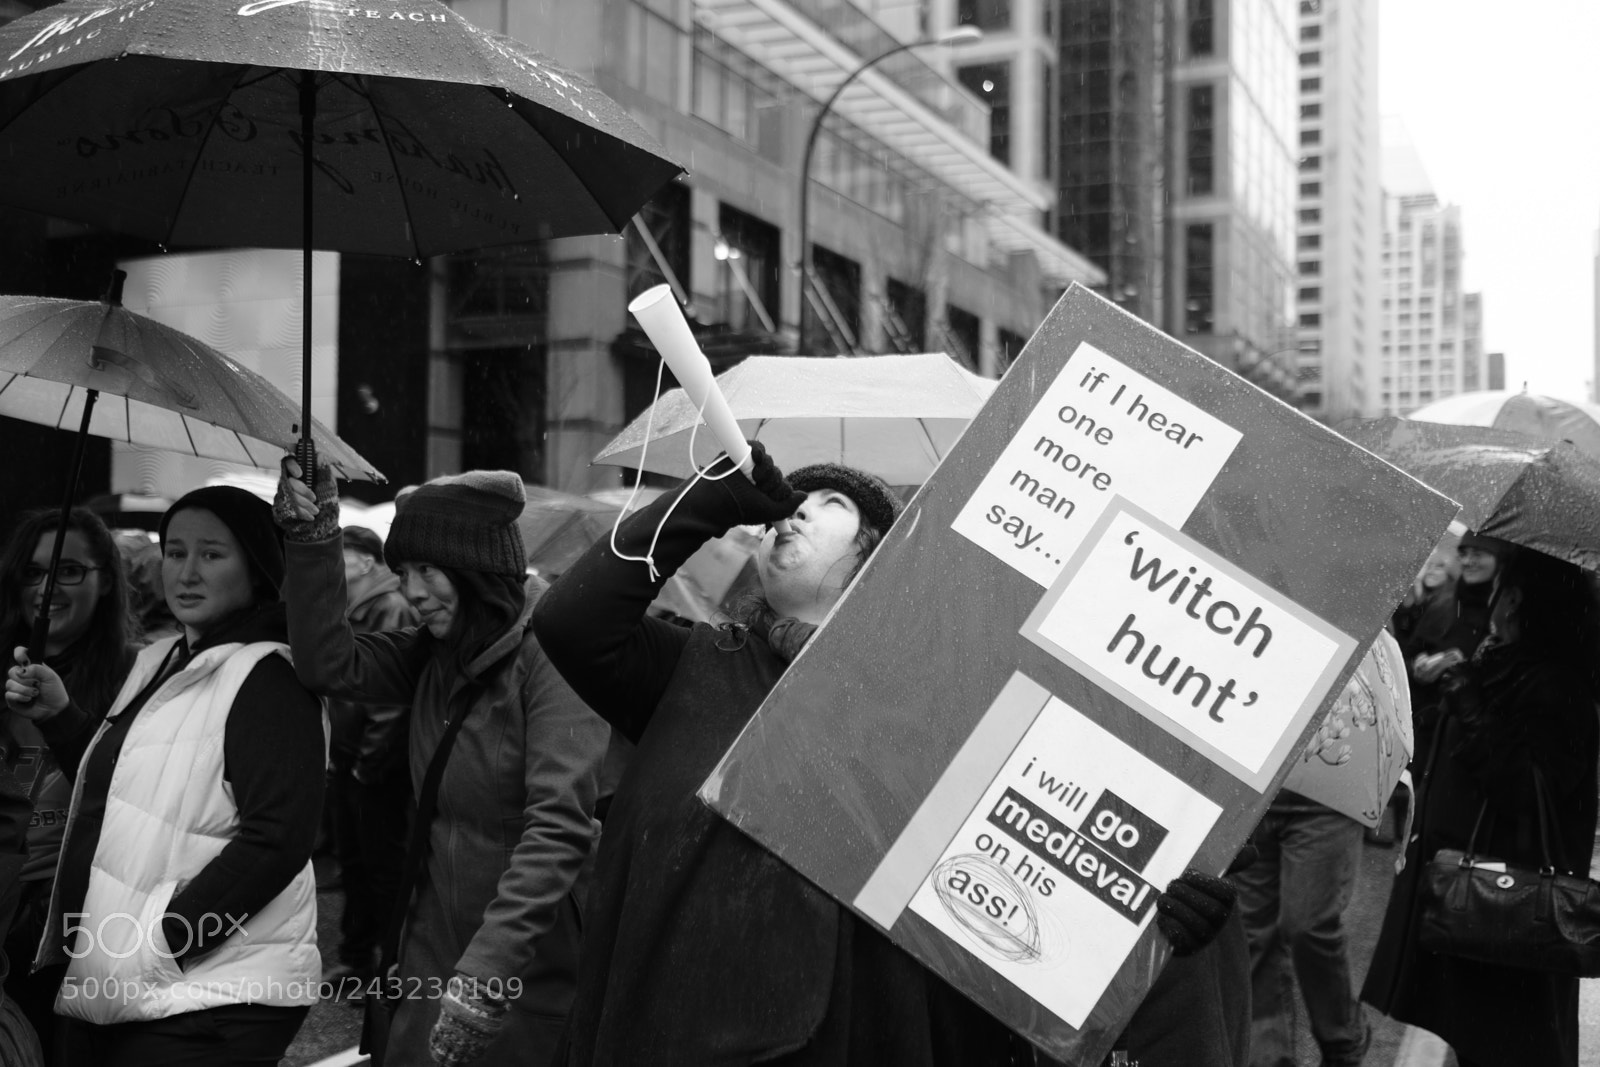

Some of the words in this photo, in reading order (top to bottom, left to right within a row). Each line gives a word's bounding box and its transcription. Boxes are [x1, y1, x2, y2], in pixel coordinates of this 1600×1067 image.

[341, 8, 447, 23] TEACH
[1058, 403, 1115, 447] one
[1078, 366, 1109, 395] if
[1109, 384, 1127, 406] I
[1126, 393, 1204, 451] hear
[1033, 433, 1113, 492] more
[1009, 468, 1077, 520] man
[985, 503, 1062, 566] say...
[29, 809, 70, 828] GBY
[1021, 756, 1038, 778] i
[1038, 769, 1088, 812] will
[1089, 803, 1141, 850] go
[974, 831, 1012, 867] on
[1012, 852, 1057, 898] his
[995, 795, 1150, 912] medieval
[947, 867, 1020, 926] ass!
